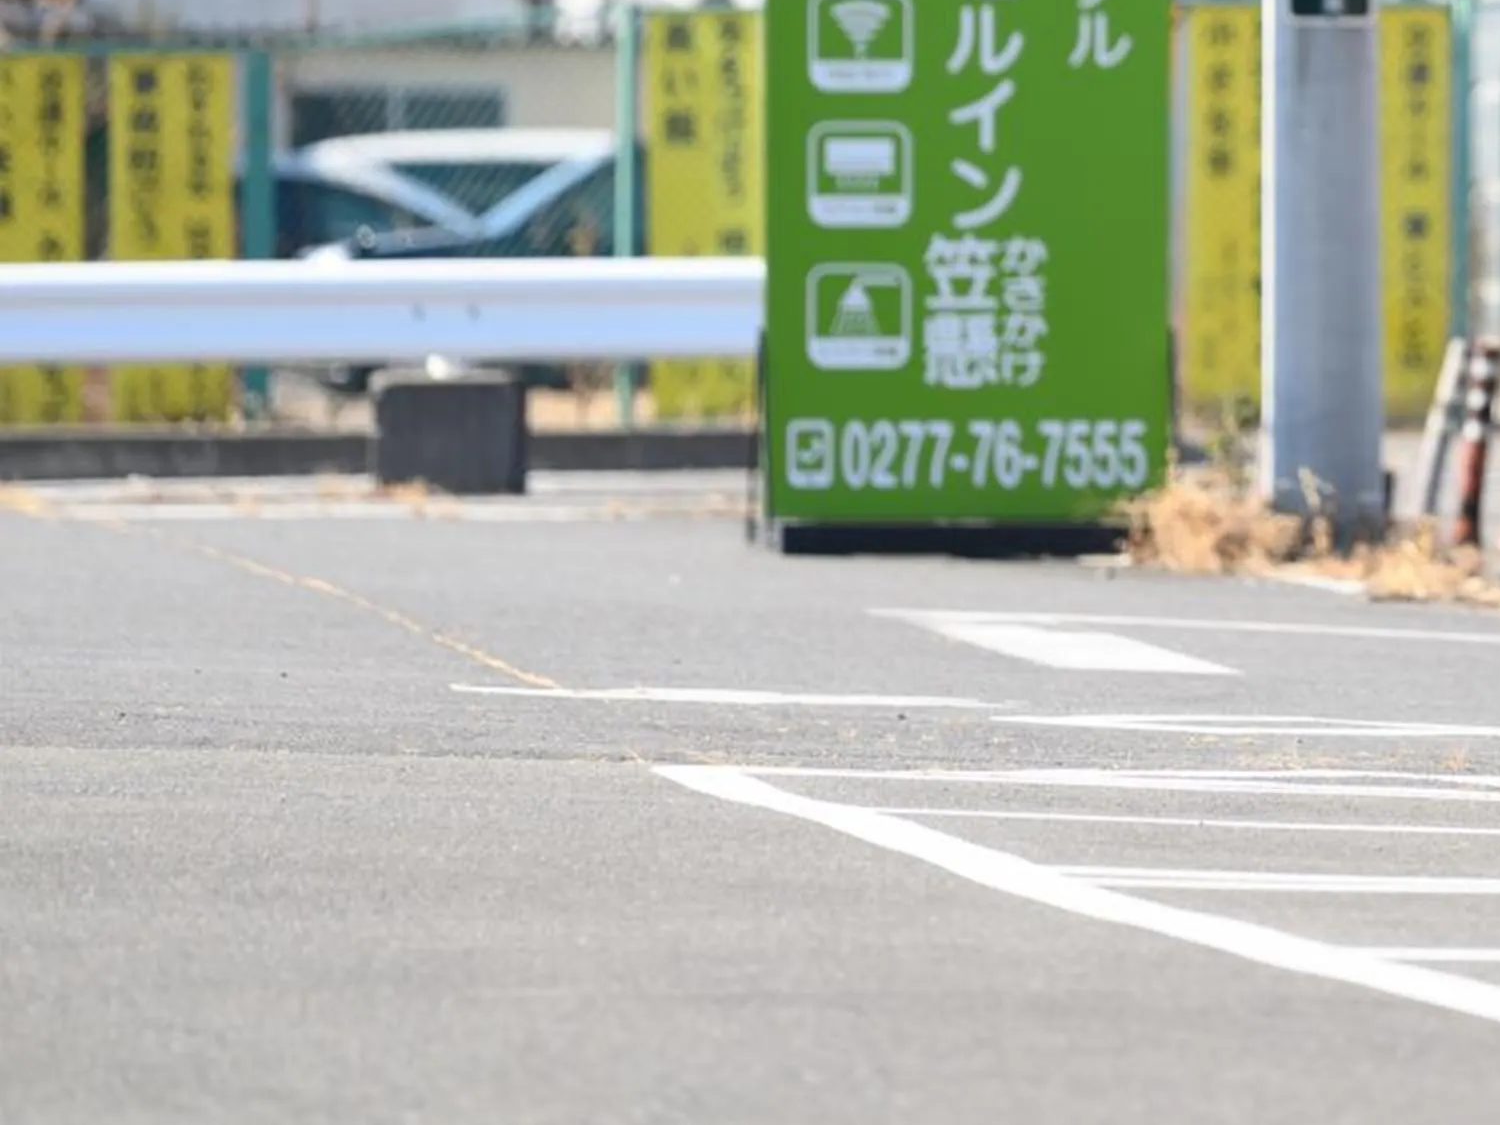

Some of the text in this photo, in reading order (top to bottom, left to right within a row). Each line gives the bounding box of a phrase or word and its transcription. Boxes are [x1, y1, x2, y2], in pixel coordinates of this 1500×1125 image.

[1001, 234, 1049, 386] かさかけ
[841, 420, 1148, 489] 0277-76-7555
